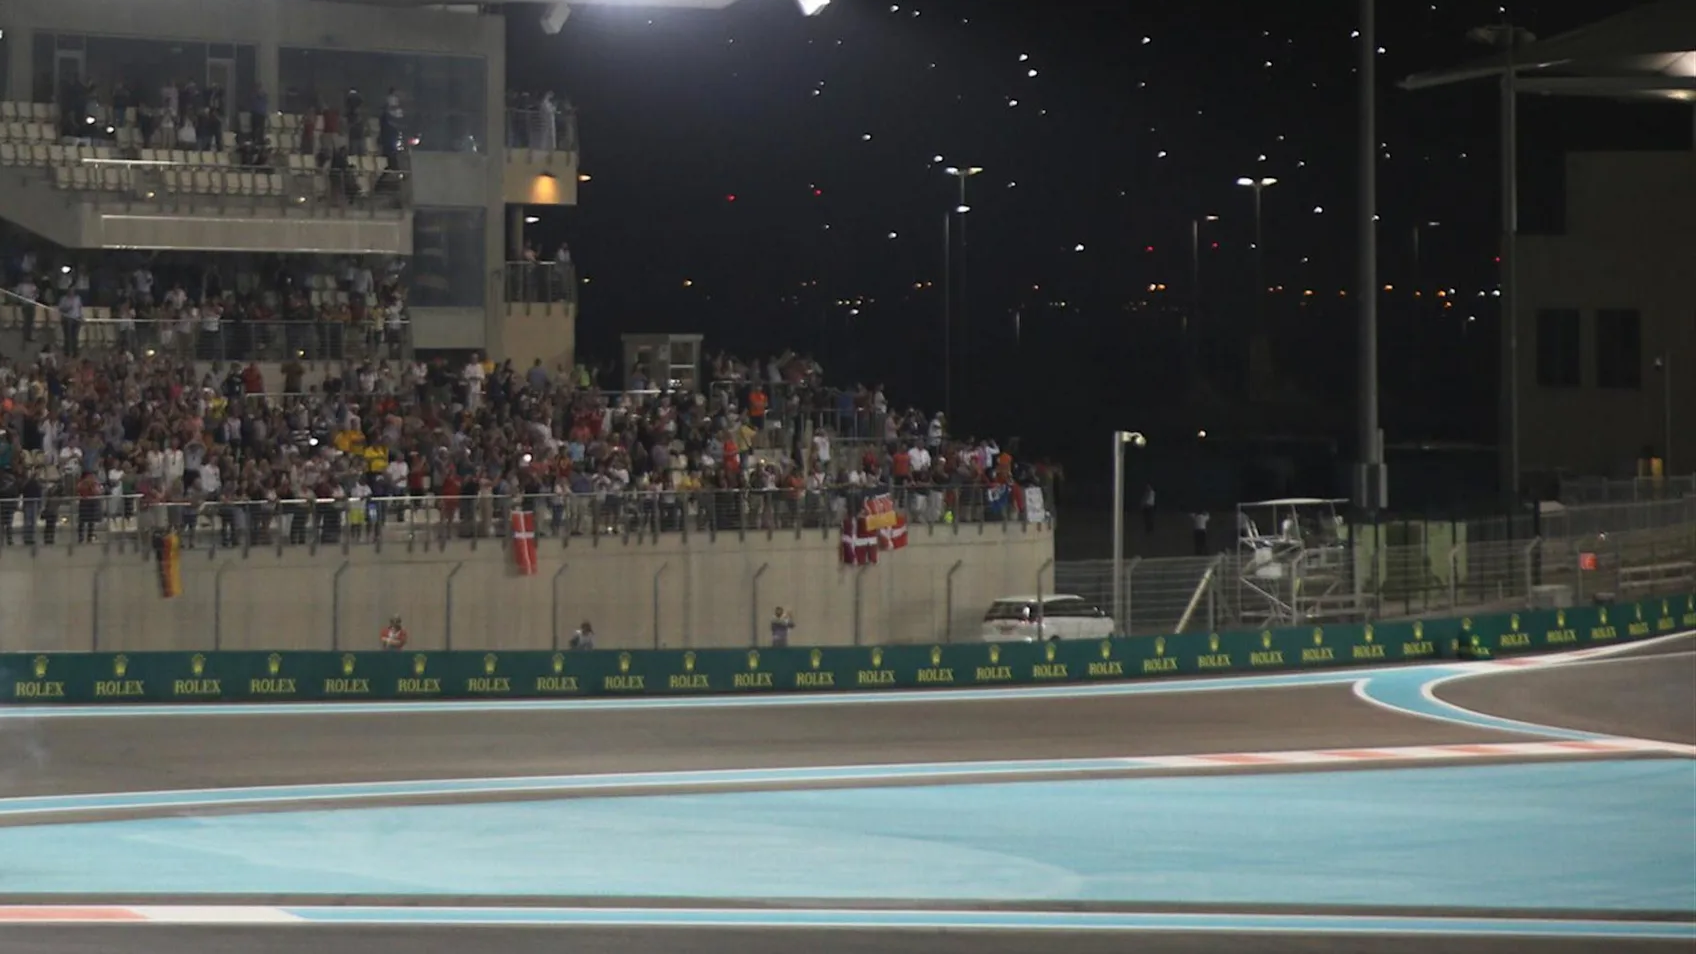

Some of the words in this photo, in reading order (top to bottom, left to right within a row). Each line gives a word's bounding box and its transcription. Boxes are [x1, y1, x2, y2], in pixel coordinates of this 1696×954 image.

[669, 674, 709, 688] ROLEX
[734, 672, 773, 687] ROLEX
[796, 671, 834, 686] ROLEX
[858, 670, 896, 684] ROLEX
[917, 668, 953, 683] ROLEX
[976, 666, 1012, 681] ROLEX
[16, 681, 64, 697] ROLEX
[96, 680, 144, 696] ROLEX
[174, 679, 221, 694] ROLEX
[251, 678, 296, 694] ROLEX
[325, 678, 370, 694] ROLEX
[398, 678, 441, 693] ROLEX
[468, 677, 511, 692] ROLEX
[537, 676, 579, 691] ROLEX
[605, 675, 644, 690] ROLEX
